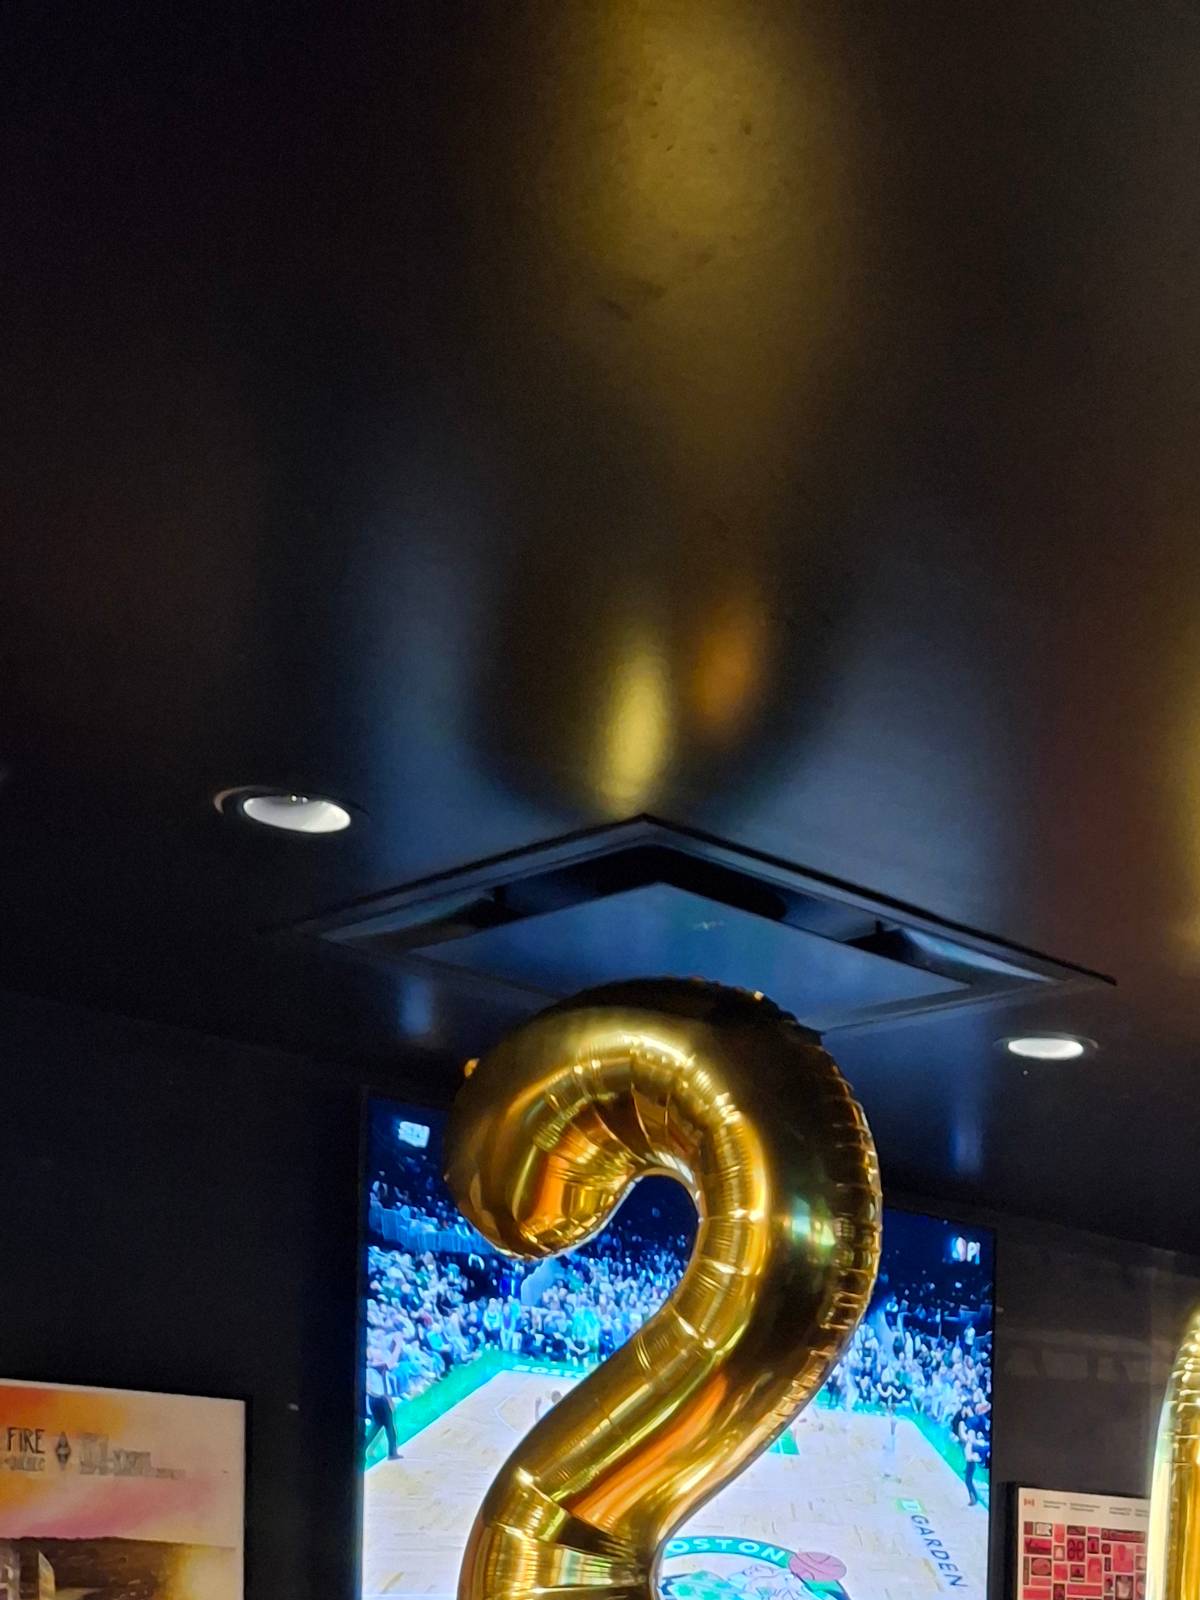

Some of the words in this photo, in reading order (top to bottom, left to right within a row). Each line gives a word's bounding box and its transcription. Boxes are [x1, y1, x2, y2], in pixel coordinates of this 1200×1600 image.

[7, 1427, 46, 1454] FIRE
[667, 1538, 786, 1562] OSTON
[911, 1514, 969, 1587] GARDEN
